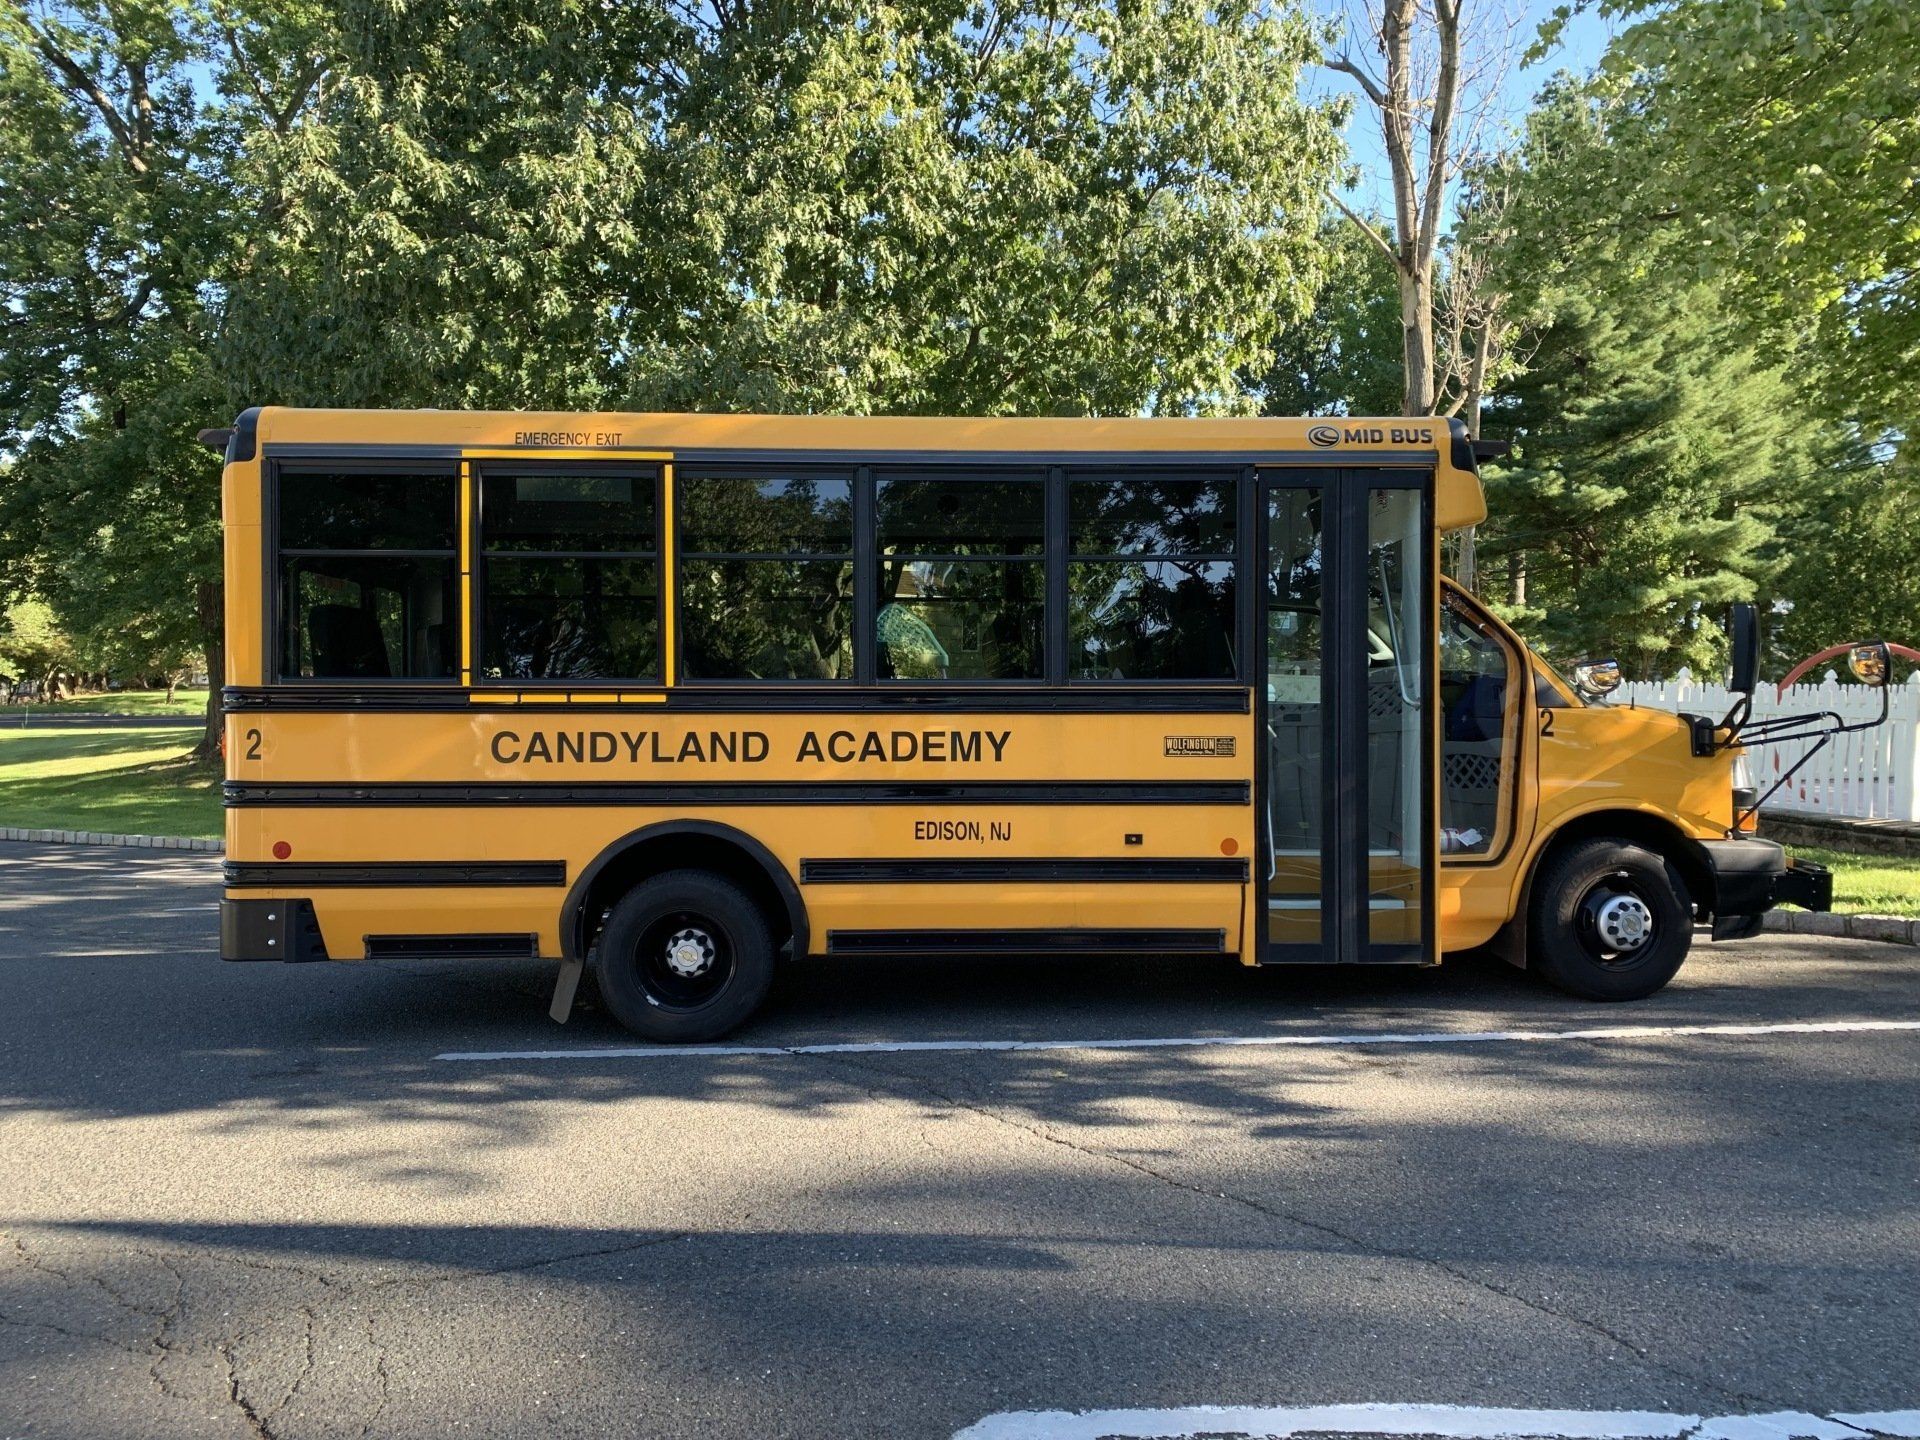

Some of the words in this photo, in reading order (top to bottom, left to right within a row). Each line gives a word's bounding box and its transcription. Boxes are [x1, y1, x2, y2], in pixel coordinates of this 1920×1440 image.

[515, 432, 591, 445] EMERGENCY
[596, 433, 622, 446] EXIT
[1344, 429, 1383, 444] MID
[1391, 429, 1433, 444] BUS
[1540, 708, 1554, 737] 2
[246, 729, 261, 760] 2
[491, 731, 769, 763] CANDYLAND
[796, 731, 1011, 763] ACADEMY
[1166, 738, 1214, 749] WOLFINGTON
[915, 821, 984, 844] EDISON,
[991, 821, 1011, 841] NJ
